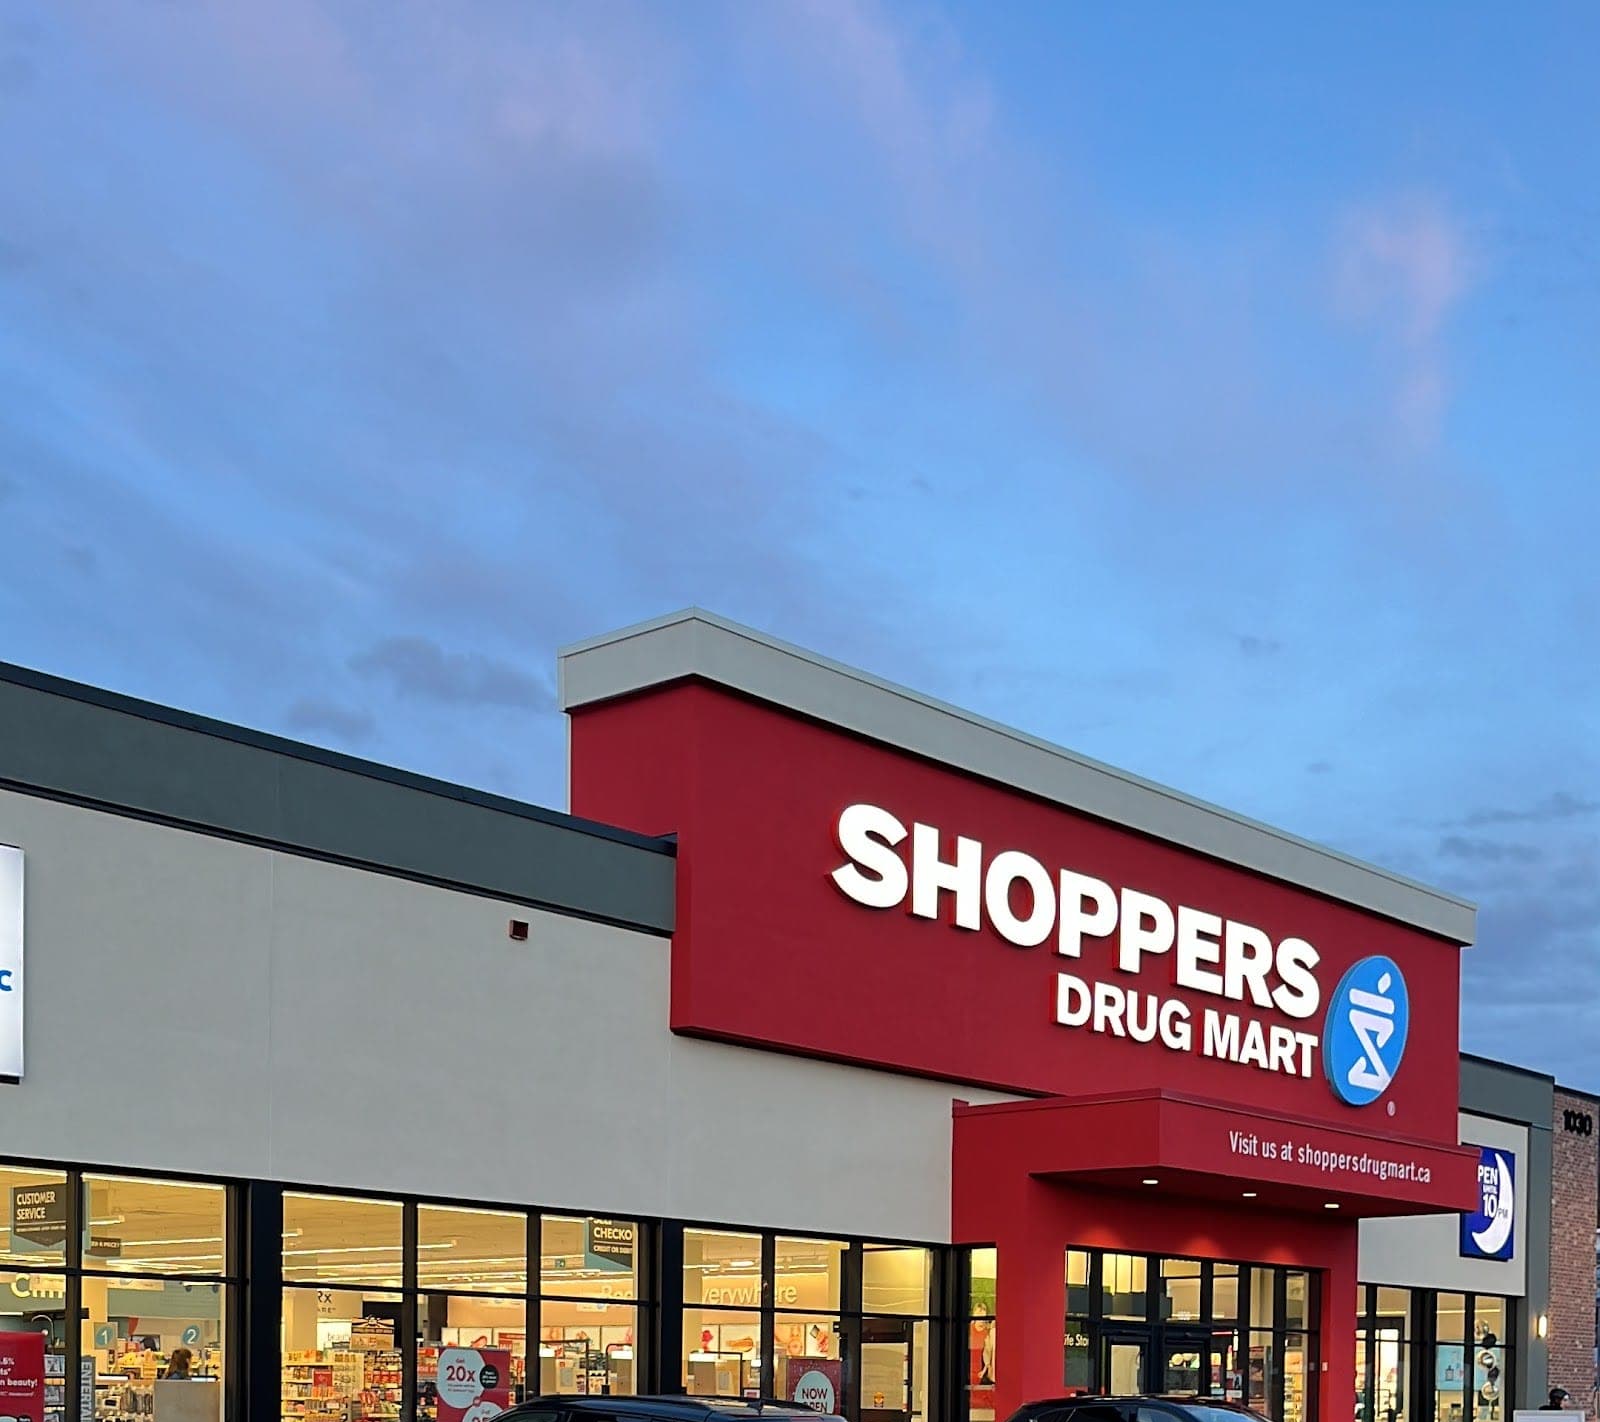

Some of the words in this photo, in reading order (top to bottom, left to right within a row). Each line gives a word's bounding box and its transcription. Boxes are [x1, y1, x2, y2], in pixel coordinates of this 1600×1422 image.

[831, 803, 1321, 1018] SHOPPERS
[1056, 972, 1192, 1051] DRUG
[1203, 1010, 1319, 1079] MART
[1563, 1109, 1592, 1137] 1030
[1229, 1131, 1258, 1156] Visit
[1262, 1141, 1277, 1159] us
[1280, 1141, 1293, 1162] at
[1297, 1143, 1431, 1183] shoppersdrugmart.ca
[16, 1191, 56, 1205] CUSTOMER
[1483, 1194, 1497, 1218] 10
[16, 1207, 46, 1220] SERVICE
[593, 1227, 632, 1240] CHECKO
[101, 1331, 108, 1344] 1
[186, 1329, 196, 1344] 2
[446, 1365, 475, 1382] 20x
[7, 1378, 38, 1388] beauty!
[802, 1388, 828, 1399] NOW
